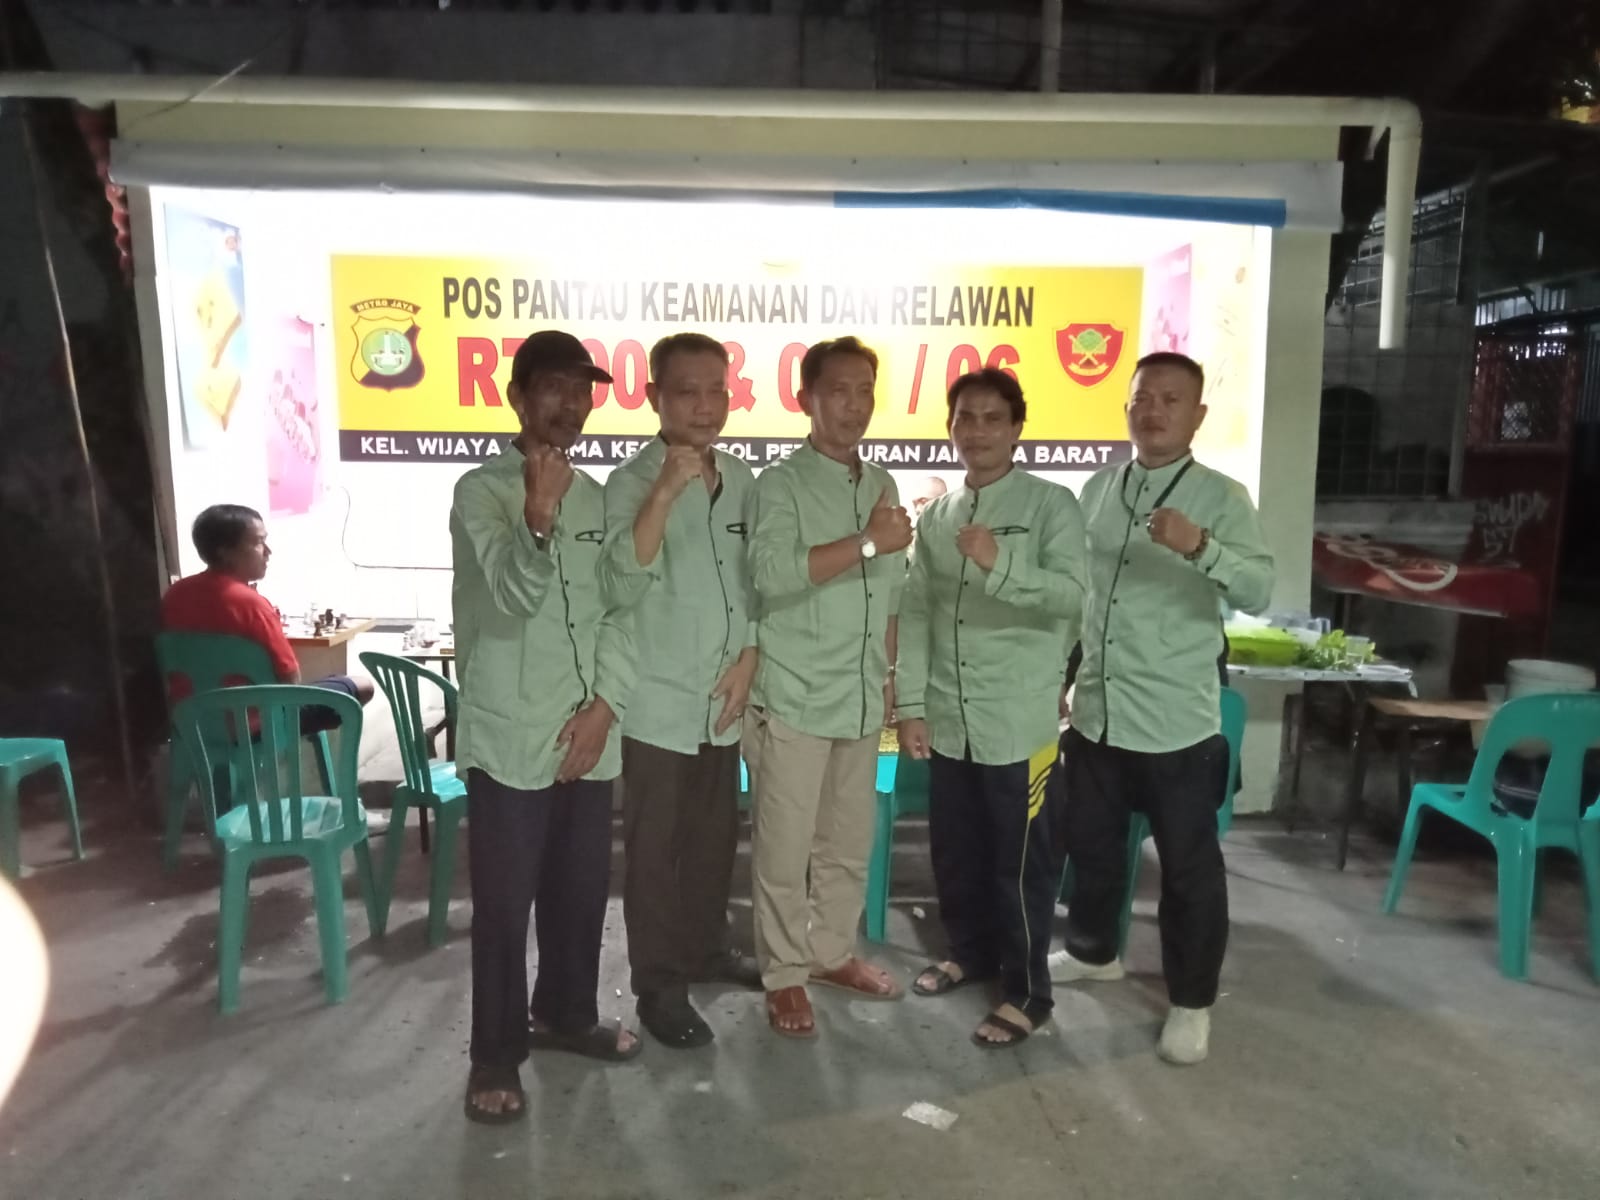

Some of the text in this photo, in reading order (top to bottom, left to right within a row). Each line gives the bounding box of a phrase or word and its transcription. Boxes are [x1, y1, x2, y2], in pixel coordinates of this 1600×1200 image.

[356, 299, 414, 313] METRO JAYA
[443, 277, 1035, 328] POS PANTAU KEAMANAN DAN RELAWAN
[908, 344, 928, 414] /
[360, 436, 409, 455] KEL.
[416, 437, 502, 457] WIJAYA
[1035, 446, 1113, 463] BARAT
